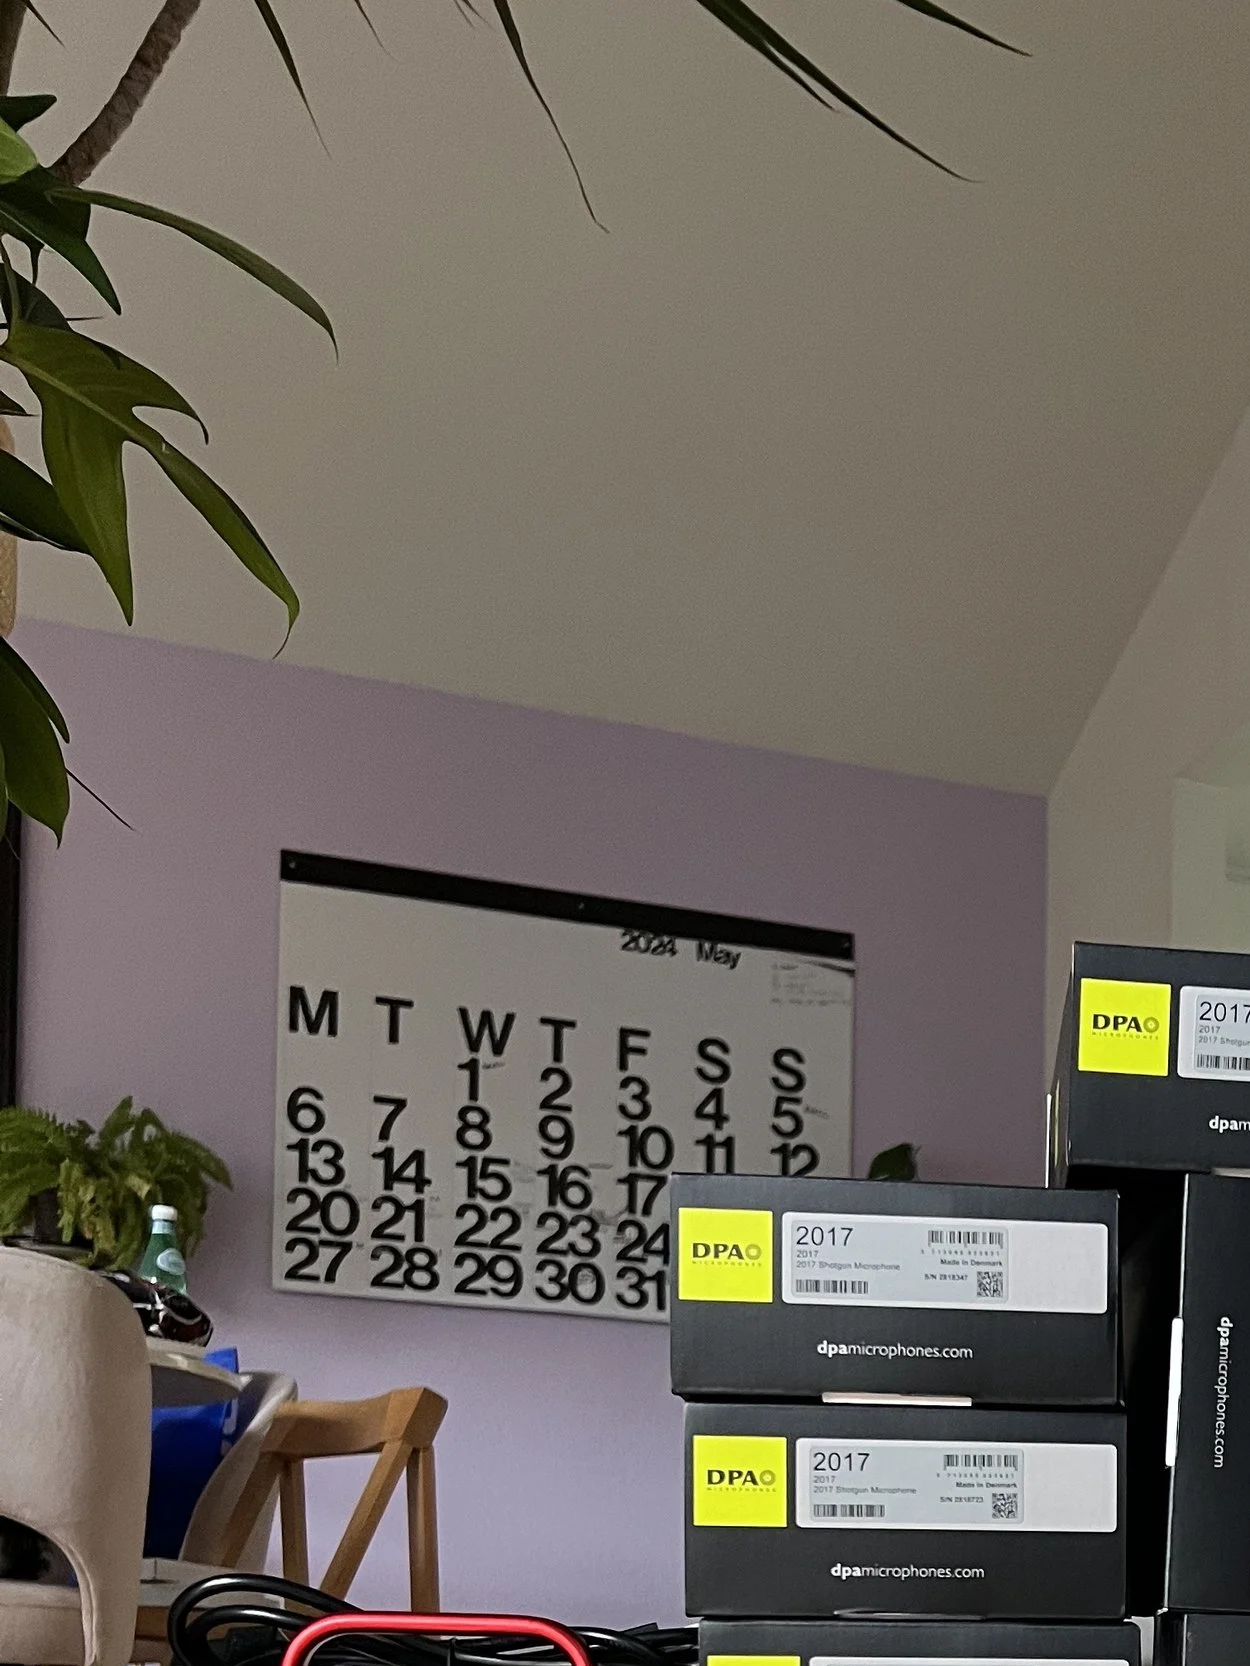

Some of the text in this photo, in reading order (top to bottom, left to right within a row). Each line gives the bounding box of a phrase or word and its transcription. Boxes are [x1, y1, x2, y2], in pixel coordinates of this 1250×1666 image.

[1093, 1014, 1141, 1032] DPA
[1199, 1025, 1220, 1033] 2017
[289, 986, 806, 1094] M T W T F S S
[1198, 1036, 1217, 1044] 2017
[457, 1057, 803, 1139] 1 2 3 4 5
[287, 1086, 819, 1177] 6 7 8 9 10 11 12
[286, 1138, 668, 1216] 13 14 15 16 17
[286, 1187, 670, 1265] 20 21 22 23 24
[797, 1226, 853, 1246] 2017
[693, 1243, 743, 1259] DPA
[797, 1250, 820, 1259] 2017
[284, 1237, 667, 1311] 27 28 29 30 31
[817, 1340, 972, 1359] dpamicrophones.com
[1214, 1317, 1233, 1467] dpamicrophones.com
[814, 1452, 869, 1471] 2017
[708, 1470, 758, 1485] DPA
[814, 1475, 835, 1484] 2017
[831, 1563, 984, 1580] dpamicrophones.com
